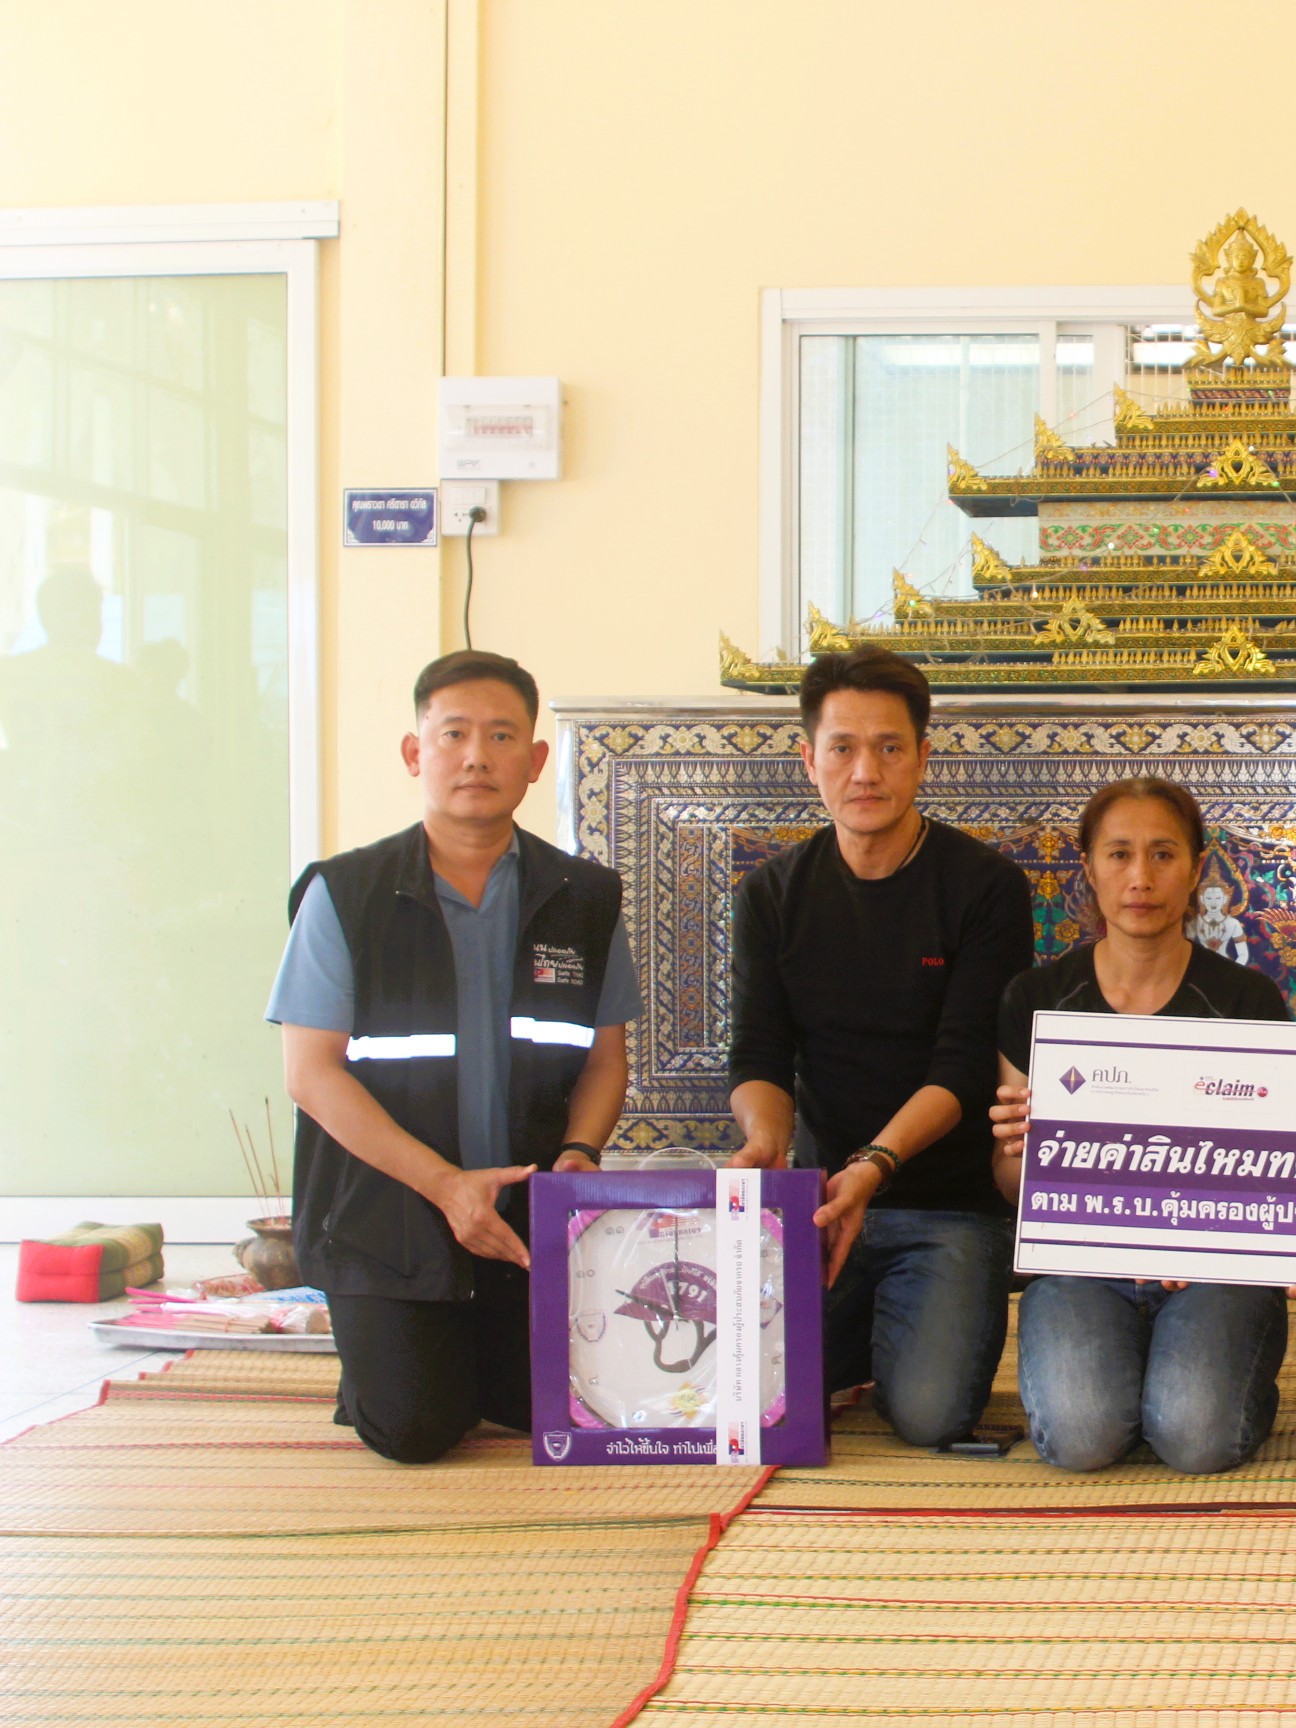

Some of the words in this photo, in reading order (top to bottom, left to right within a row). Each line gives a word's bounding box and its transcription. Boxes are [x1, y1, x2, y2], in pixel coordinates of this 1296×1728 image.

[372, 520, 395, 531] 10,000
[396, 520, 409, 530] บาท
[921, 957, 945, 966] POLO
[1092, 1066, 1132, 1084] คปภ.
[1031, 1190, 1078, 1212] ตาม
[606, 1437, 670, 1455] จำไว้ให้ขึ้นใจ
